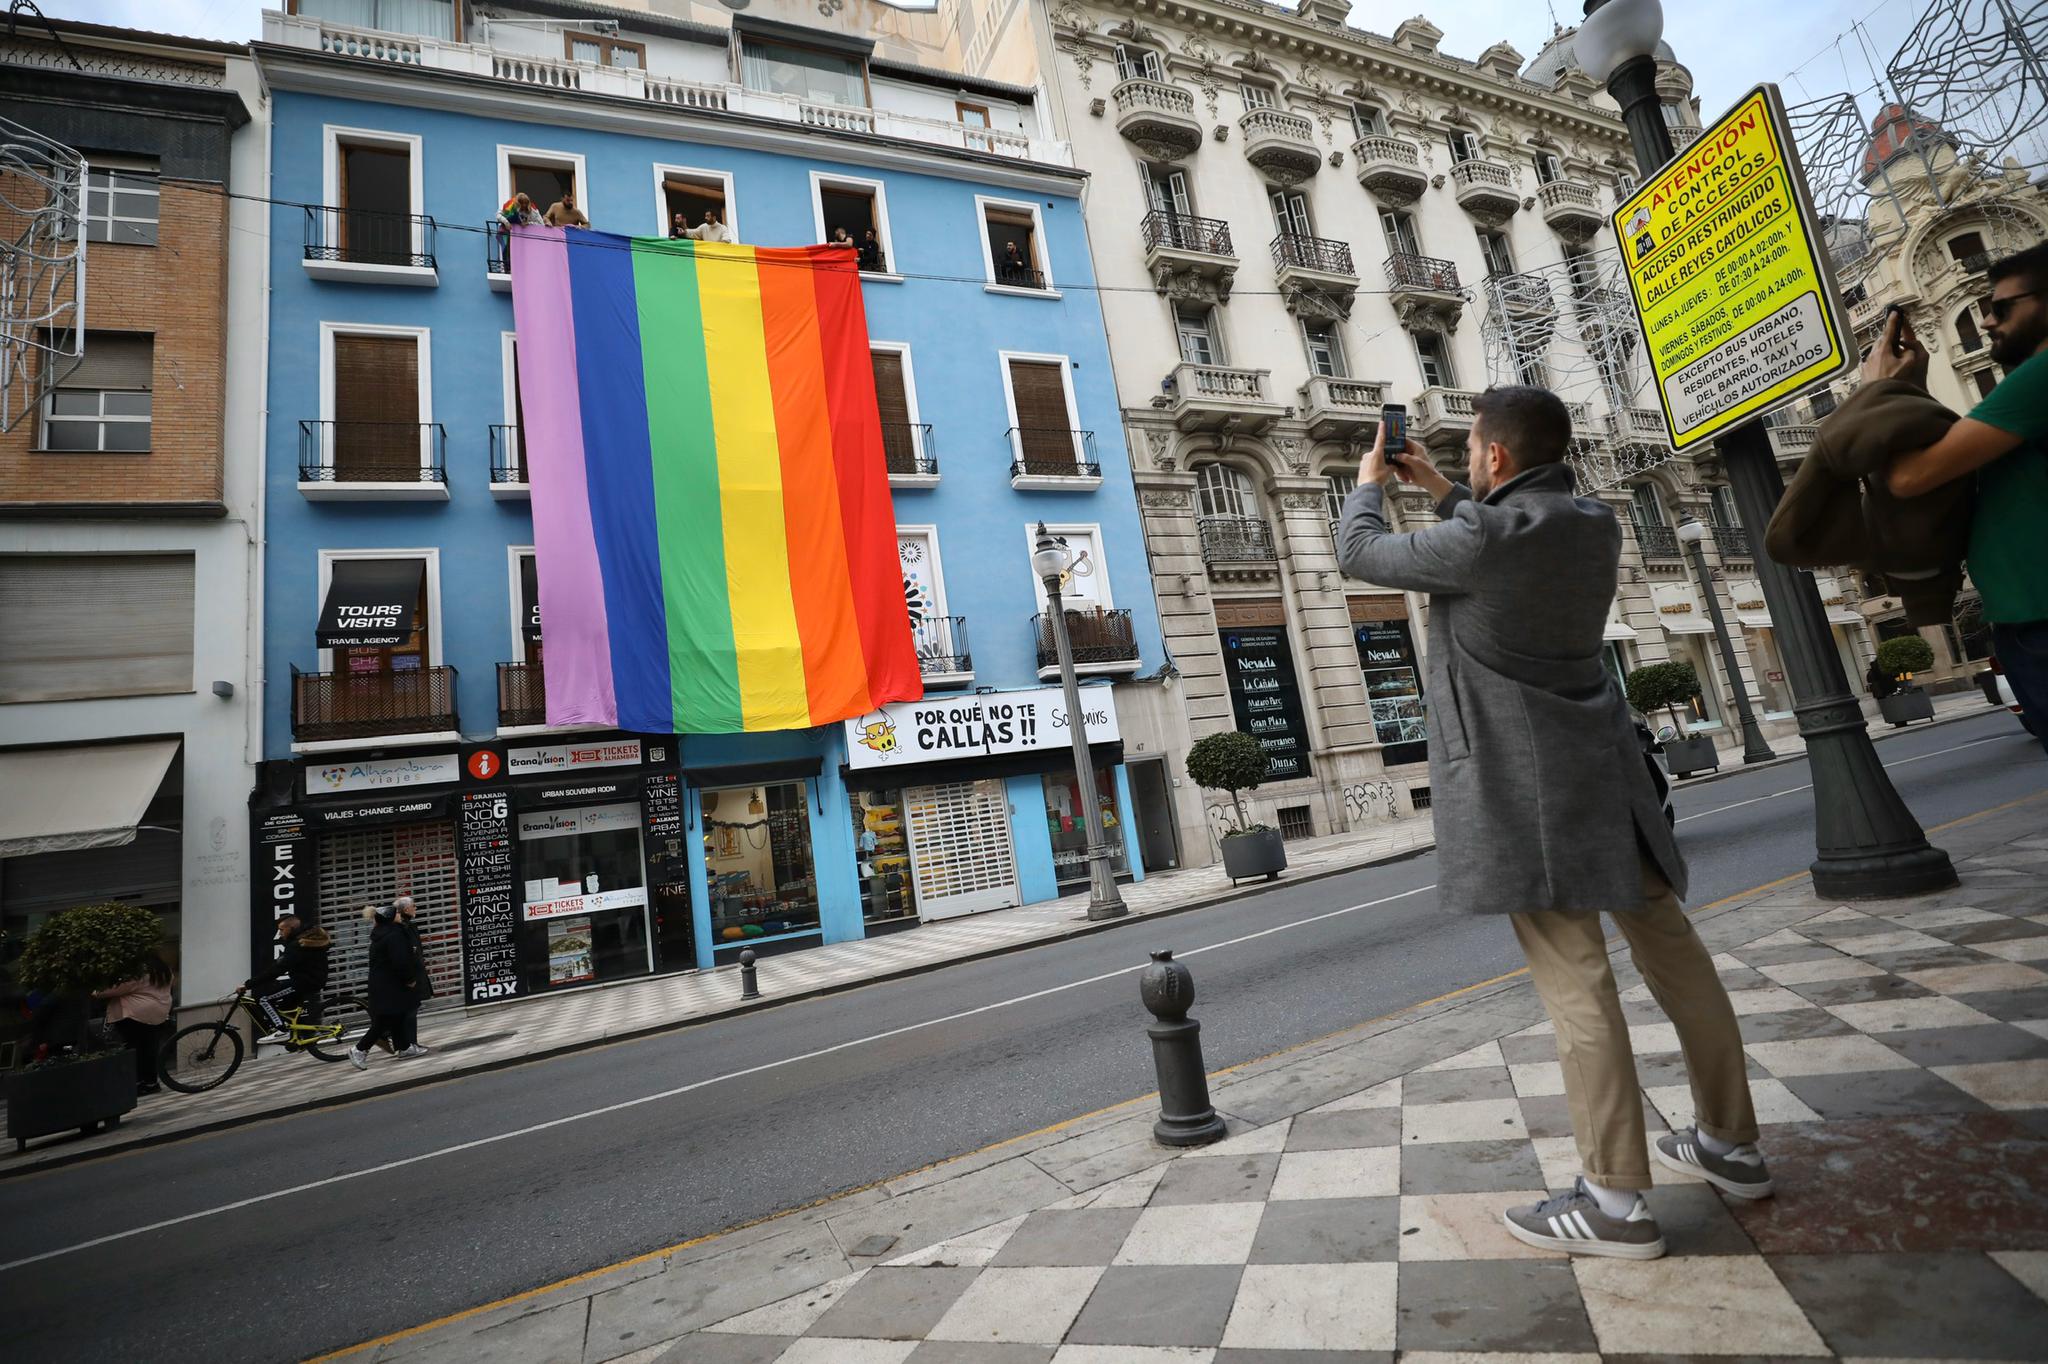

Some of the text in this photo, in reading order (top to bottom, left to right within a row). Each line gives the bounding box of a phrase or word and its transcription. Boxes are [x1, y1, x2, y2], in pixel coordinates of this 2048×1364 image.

[1652, 113, 1756, 210] ATENCIÓN
[1668, 149, 1747, 215] CONTROL
[1661, 152, 1765, 241] DE ACCESOS
[1643, 175, 1774, 285] ACCESO RESTRINGIDO
[1647, 198, 1782, 303] CALLE REYES CATÓLICOS
[1715, 221, 1793, 284] DE 00:00 A 02:00h. Y
[1718, 244, 1791, 297] DE 07:30 A 24:00h.
[1732, 267, 1806, 319] DE 00:00 A 24:00h.
[1650, 313, 1674, 335] LUNES
[1674, 309, 1680, 320] A
[1680, 289, 1711, 316] JUEVES
[1659, 307, 1729, 357] VIERNES SÁBADOS,
[1661, 320, 1735, 372] DOMINGOS Y FESTIVOS:
[1678, 306, 1803, 385] EXCEPTO BUS URBANO,
[1683, 321, 1804, 397] RESIDENTES, HOTELES
[1682, 344, 1823, 426] VEHÍCULOS AUTORIZADOS
[1696, 339, 1799, 405] DEL BARRIO, TAXI Y
[337, 617, 397, 628] VISITS
[338, 604, 402, 616] TOURS
[327, 636, 400, 646] TRAVEL AGENCY
[1238, 656, 1276, 670] Nevada
[1368, 649, 1400, 661] Nevada
[915, 702, 1036, 726] POR QUÉ NO TE
[917, 722, 1014, 750] CALLAS
[350, 760, 444, 778] Alhambra
[602, 745, 639, 755] TICKETS
[370, 774, 422, 786] viajes
[542, 785, 616, 798] URBAN SOUVENIR ROOM
[325, 810, 353, 820] VIAJES
[359, 806, 394, 817] CHANGE
[400, 803, 432, 812] CAMBIO
[467, 902, 511, 916] VINO
[554, 899, 584, 909] TICKETS
